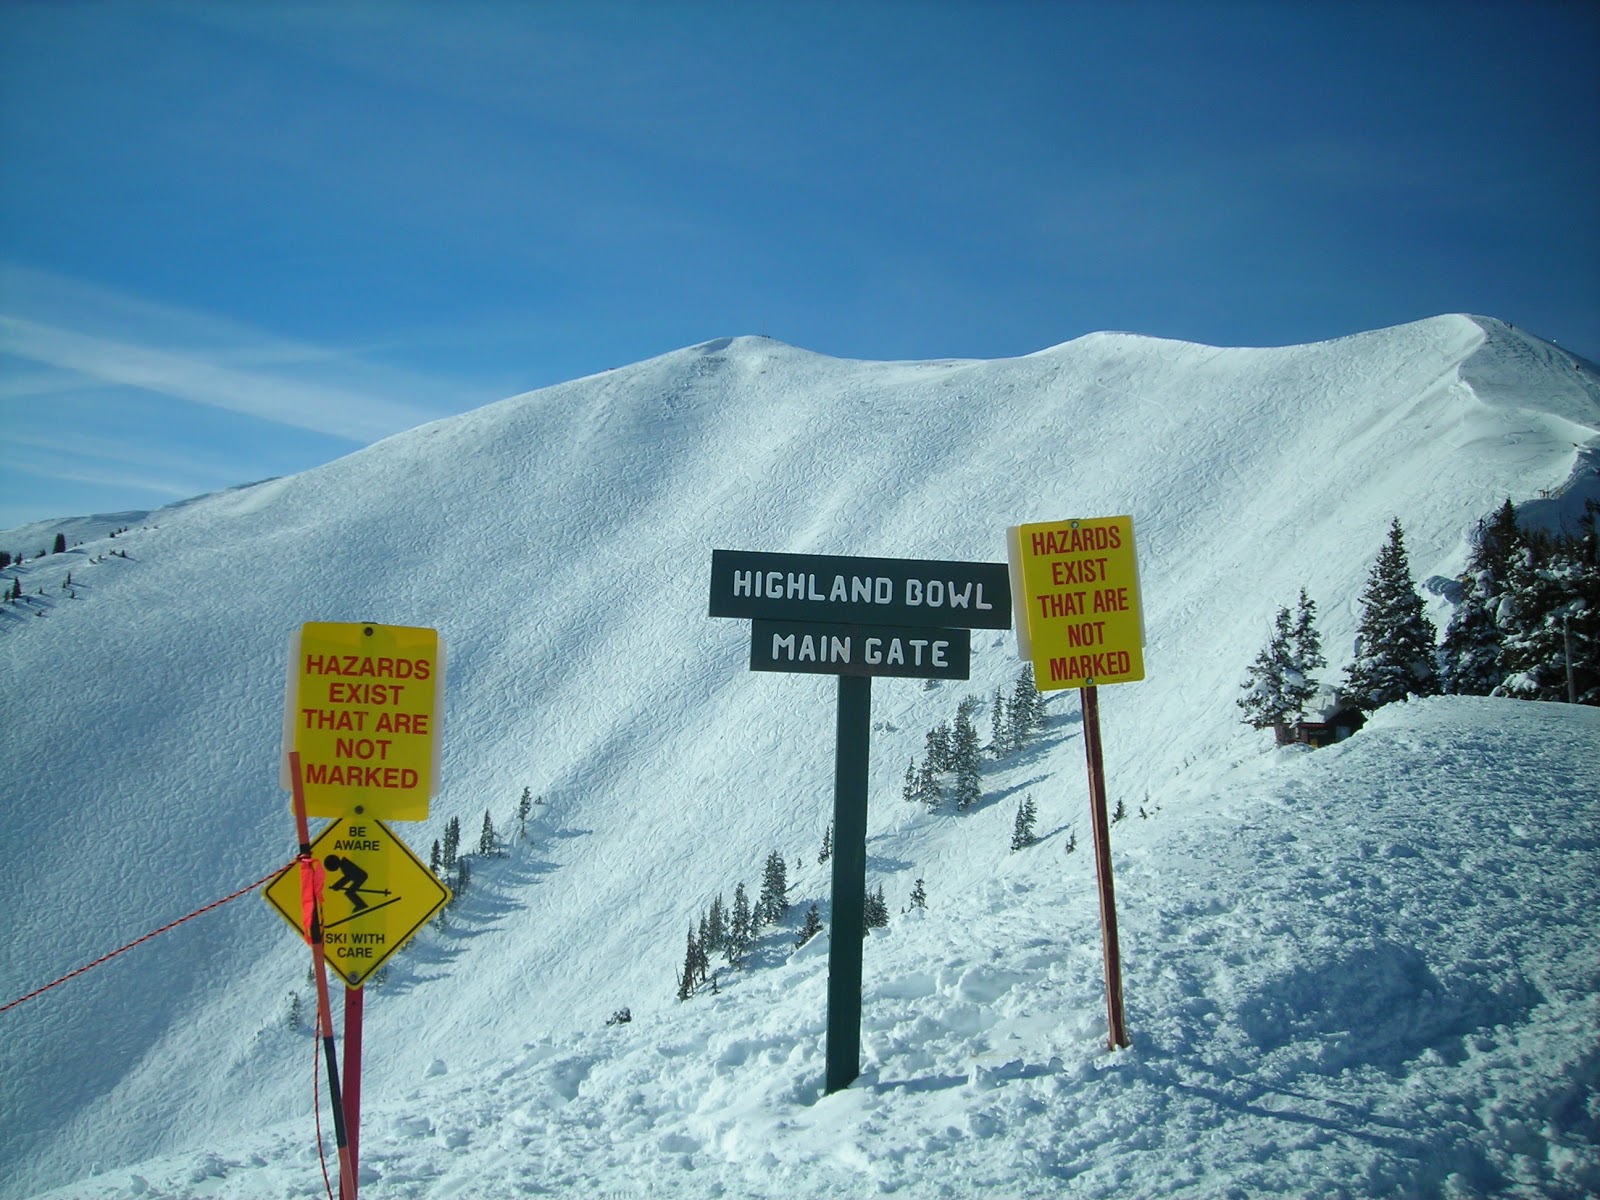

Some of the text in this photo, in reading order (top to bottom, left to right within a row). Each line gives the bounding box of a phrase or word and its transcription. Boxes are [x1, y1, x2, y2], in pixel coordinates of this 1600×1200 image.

[1031, 525, 1122, 556] HAZARDS
[1051, 557, 1108, 586] EXIST
[733, 569, 993, 610] HIGHLAND BOWL
[1037, 587, 1129, 618] THAT ARE
[1067, 621, 1106, 648] NOT
[772, 633, 949, 668] MAIN GATE
[306, 654, 430, 680] HAZARDS
[1050, 650, 1131, 682] MARKED
[329, 682, 404, 705] EXIST
[302, 708, 428, 735] THAT ARE
[335, 738, 392, 760] NOT
[305, 764, 419, 789] MARKED
[349, 826, 366, 837] BE
[333, 840, 380, 851] AWARE
[325, 933, 385, 944] SKI WITH
[337, 947, 373, 958] CARE
